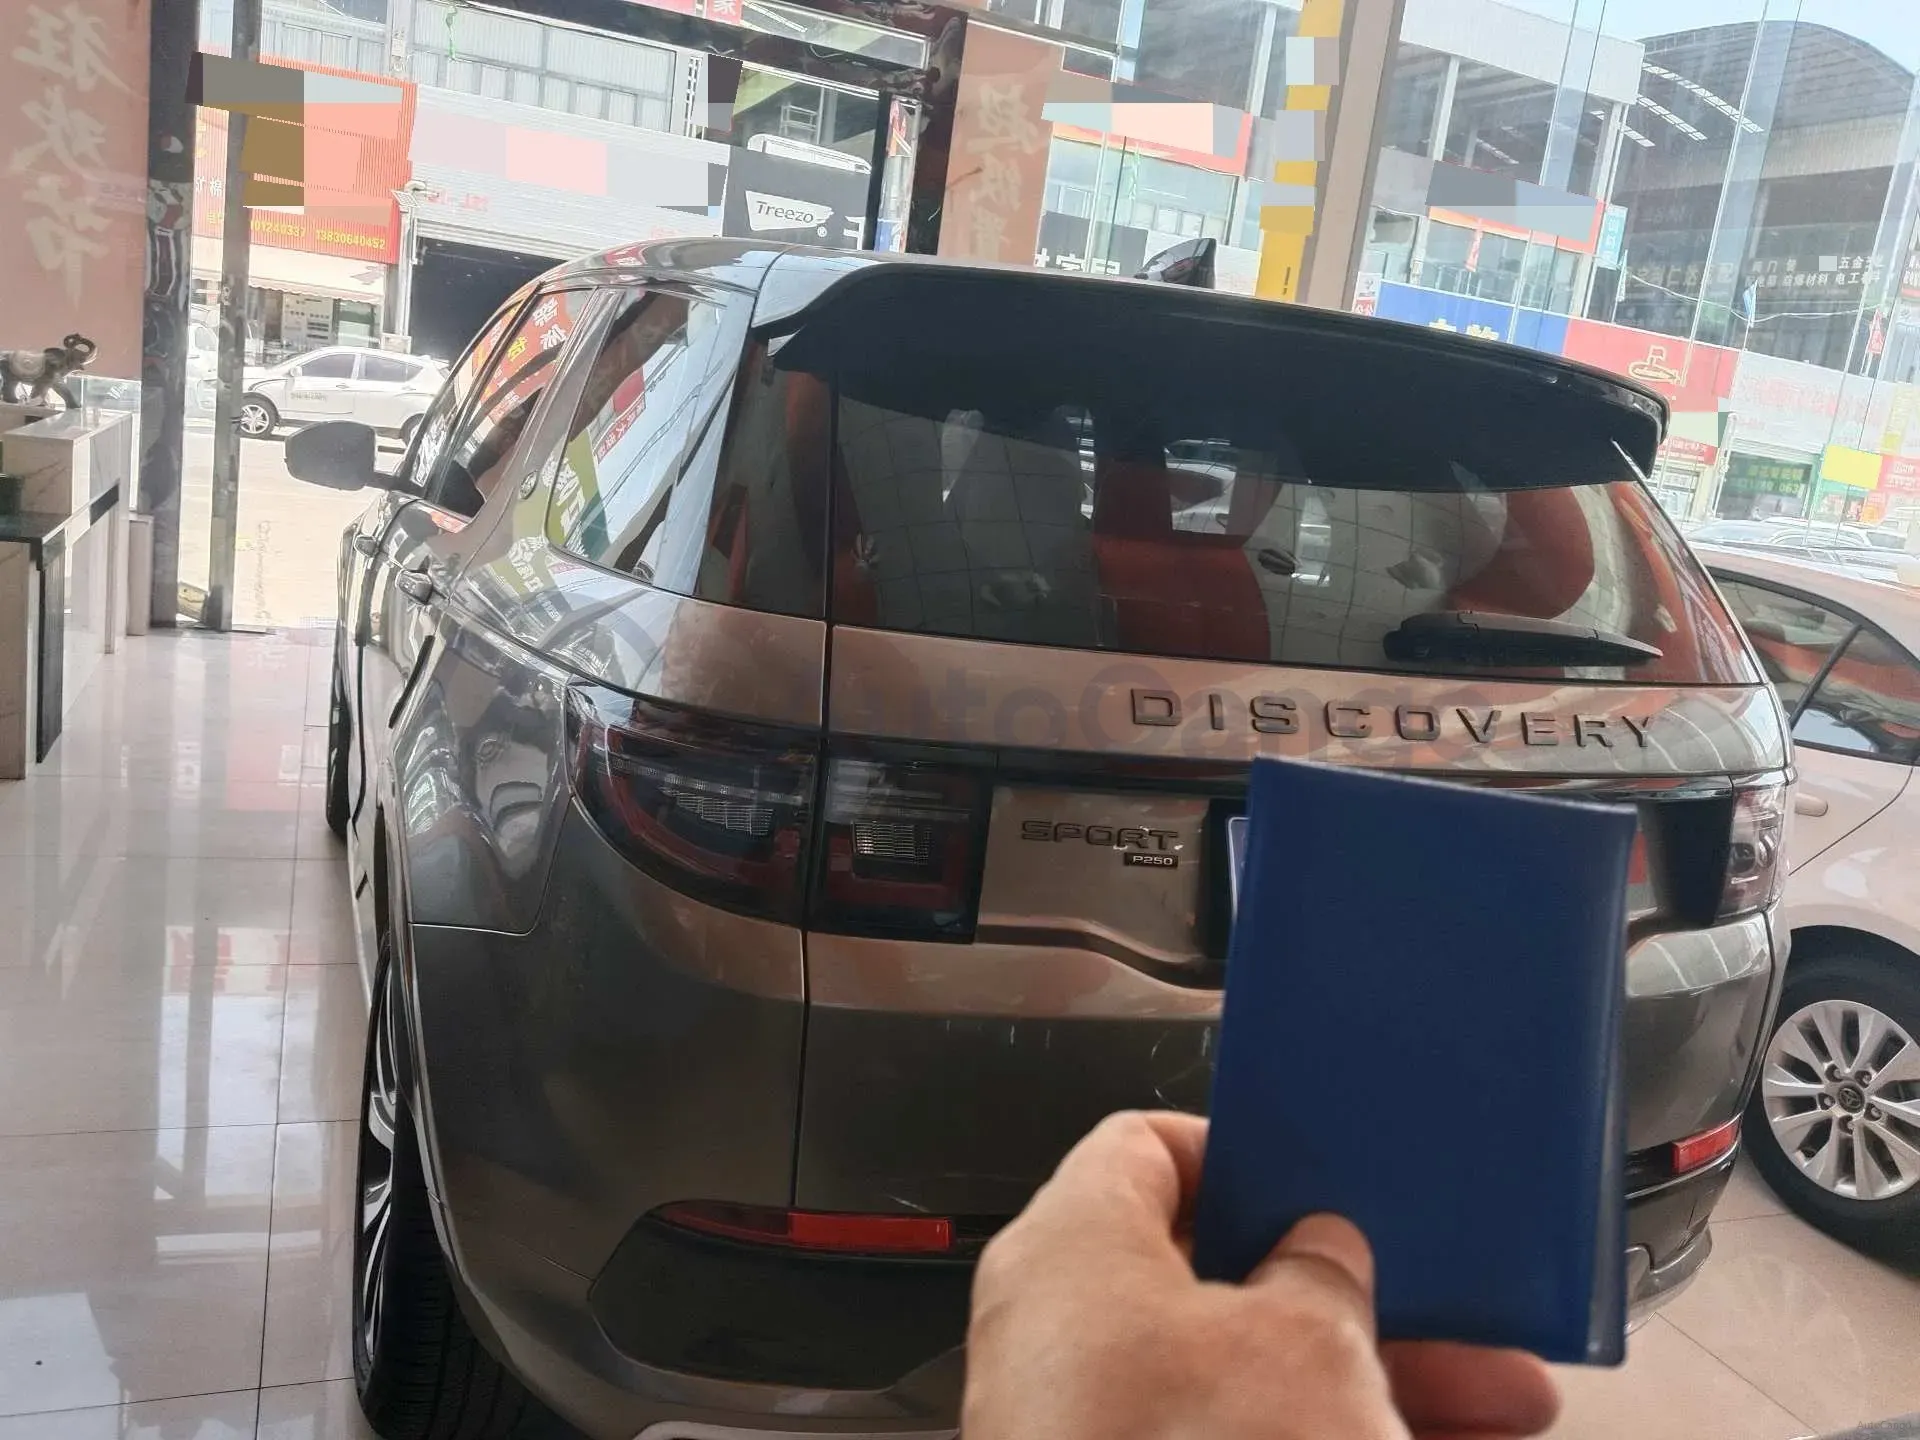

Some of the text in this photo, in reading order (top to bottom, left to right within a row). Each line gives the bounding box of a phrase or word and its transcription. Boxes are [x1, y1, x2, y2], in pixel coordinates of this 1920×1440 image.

[756, 200, 815, 224] Treezo
[1131, 687, 1656, 749] DISCOVERY
[1021, 819, 1179, 850] SPORT
[1132, 855, 1174, 867] P250
